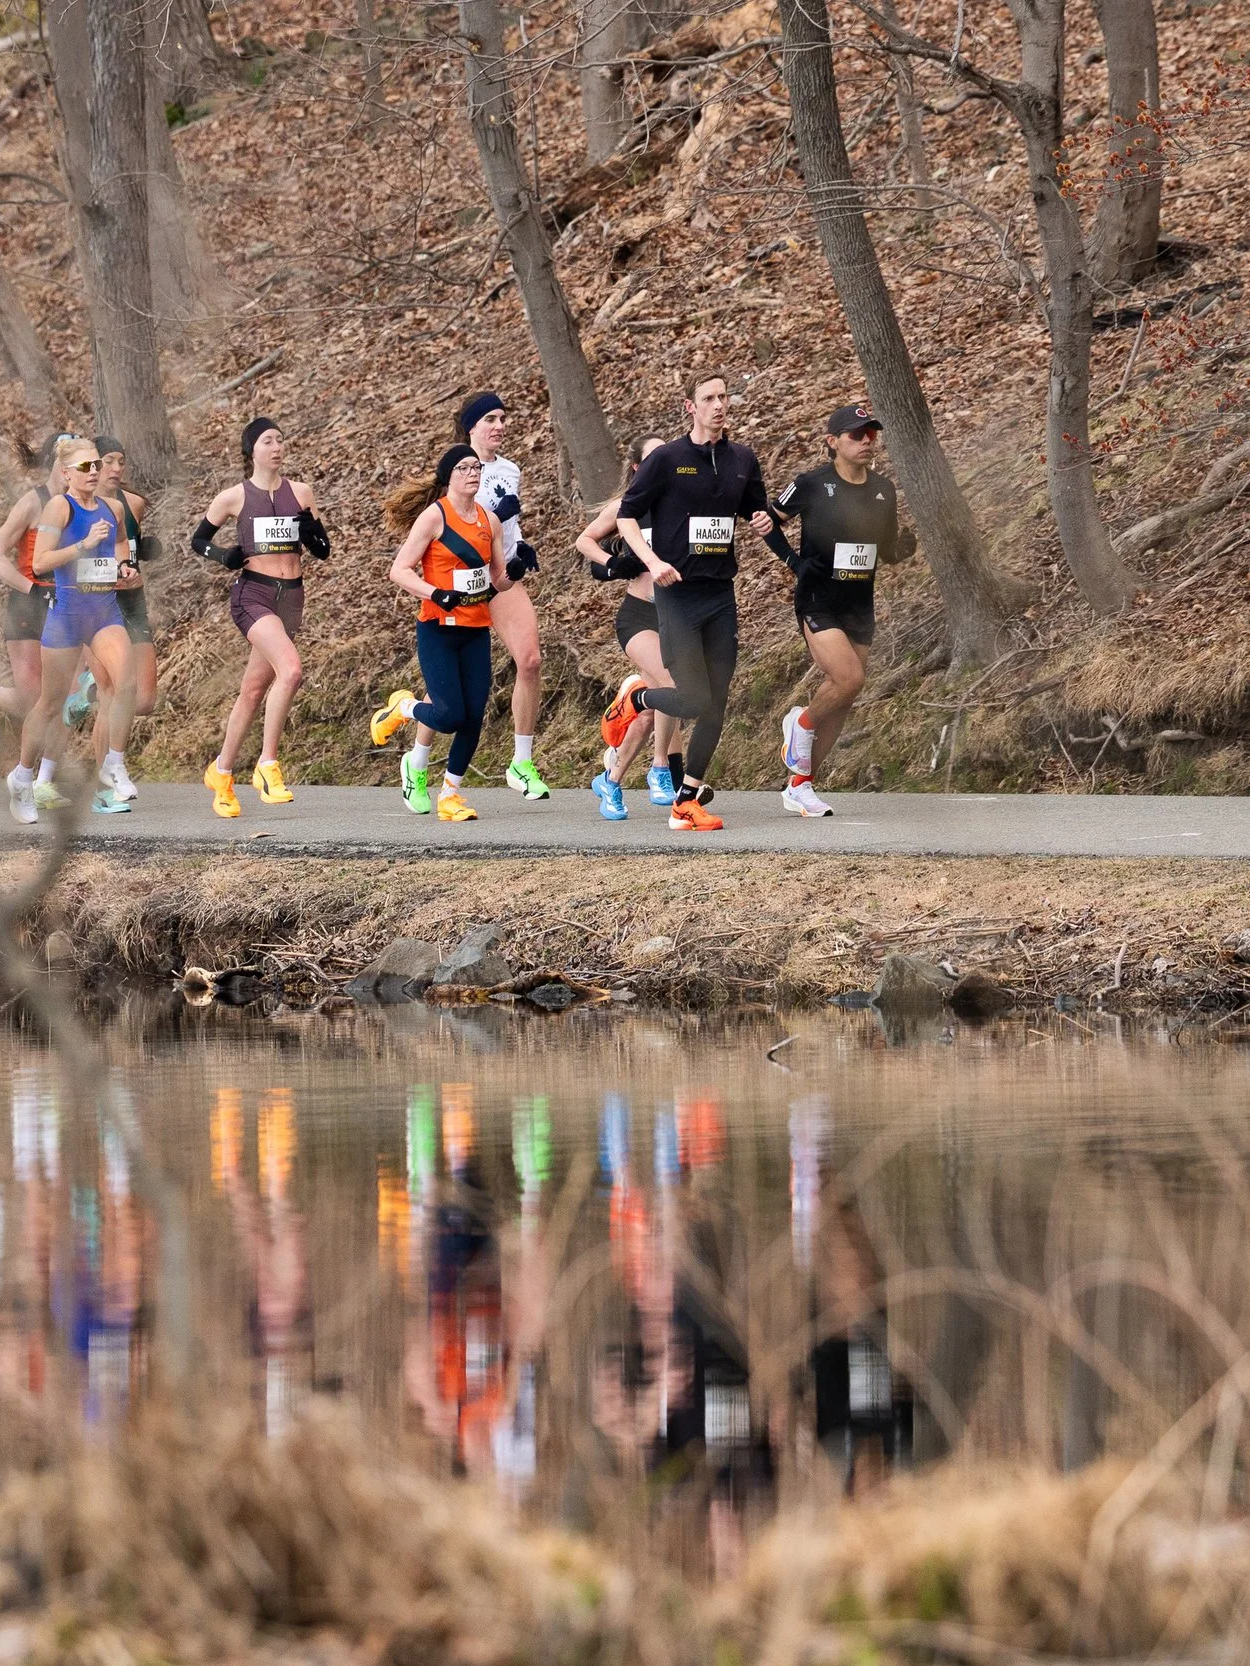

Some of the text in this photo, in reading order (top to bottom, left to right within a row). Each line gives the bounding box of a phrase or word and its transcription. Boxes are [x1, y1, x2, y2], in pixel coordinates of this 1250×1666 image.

[274, 518, 285, 526] 77
[710, 519, 721, 527] 31
[696, 528, 731, 540] HAAGSMA
[856, 545, 865, 553] 17
[93, 559, 108, 567] 103
[850, 555, 868, 566] CRUZ
[473, 569, 483, 578] 90
